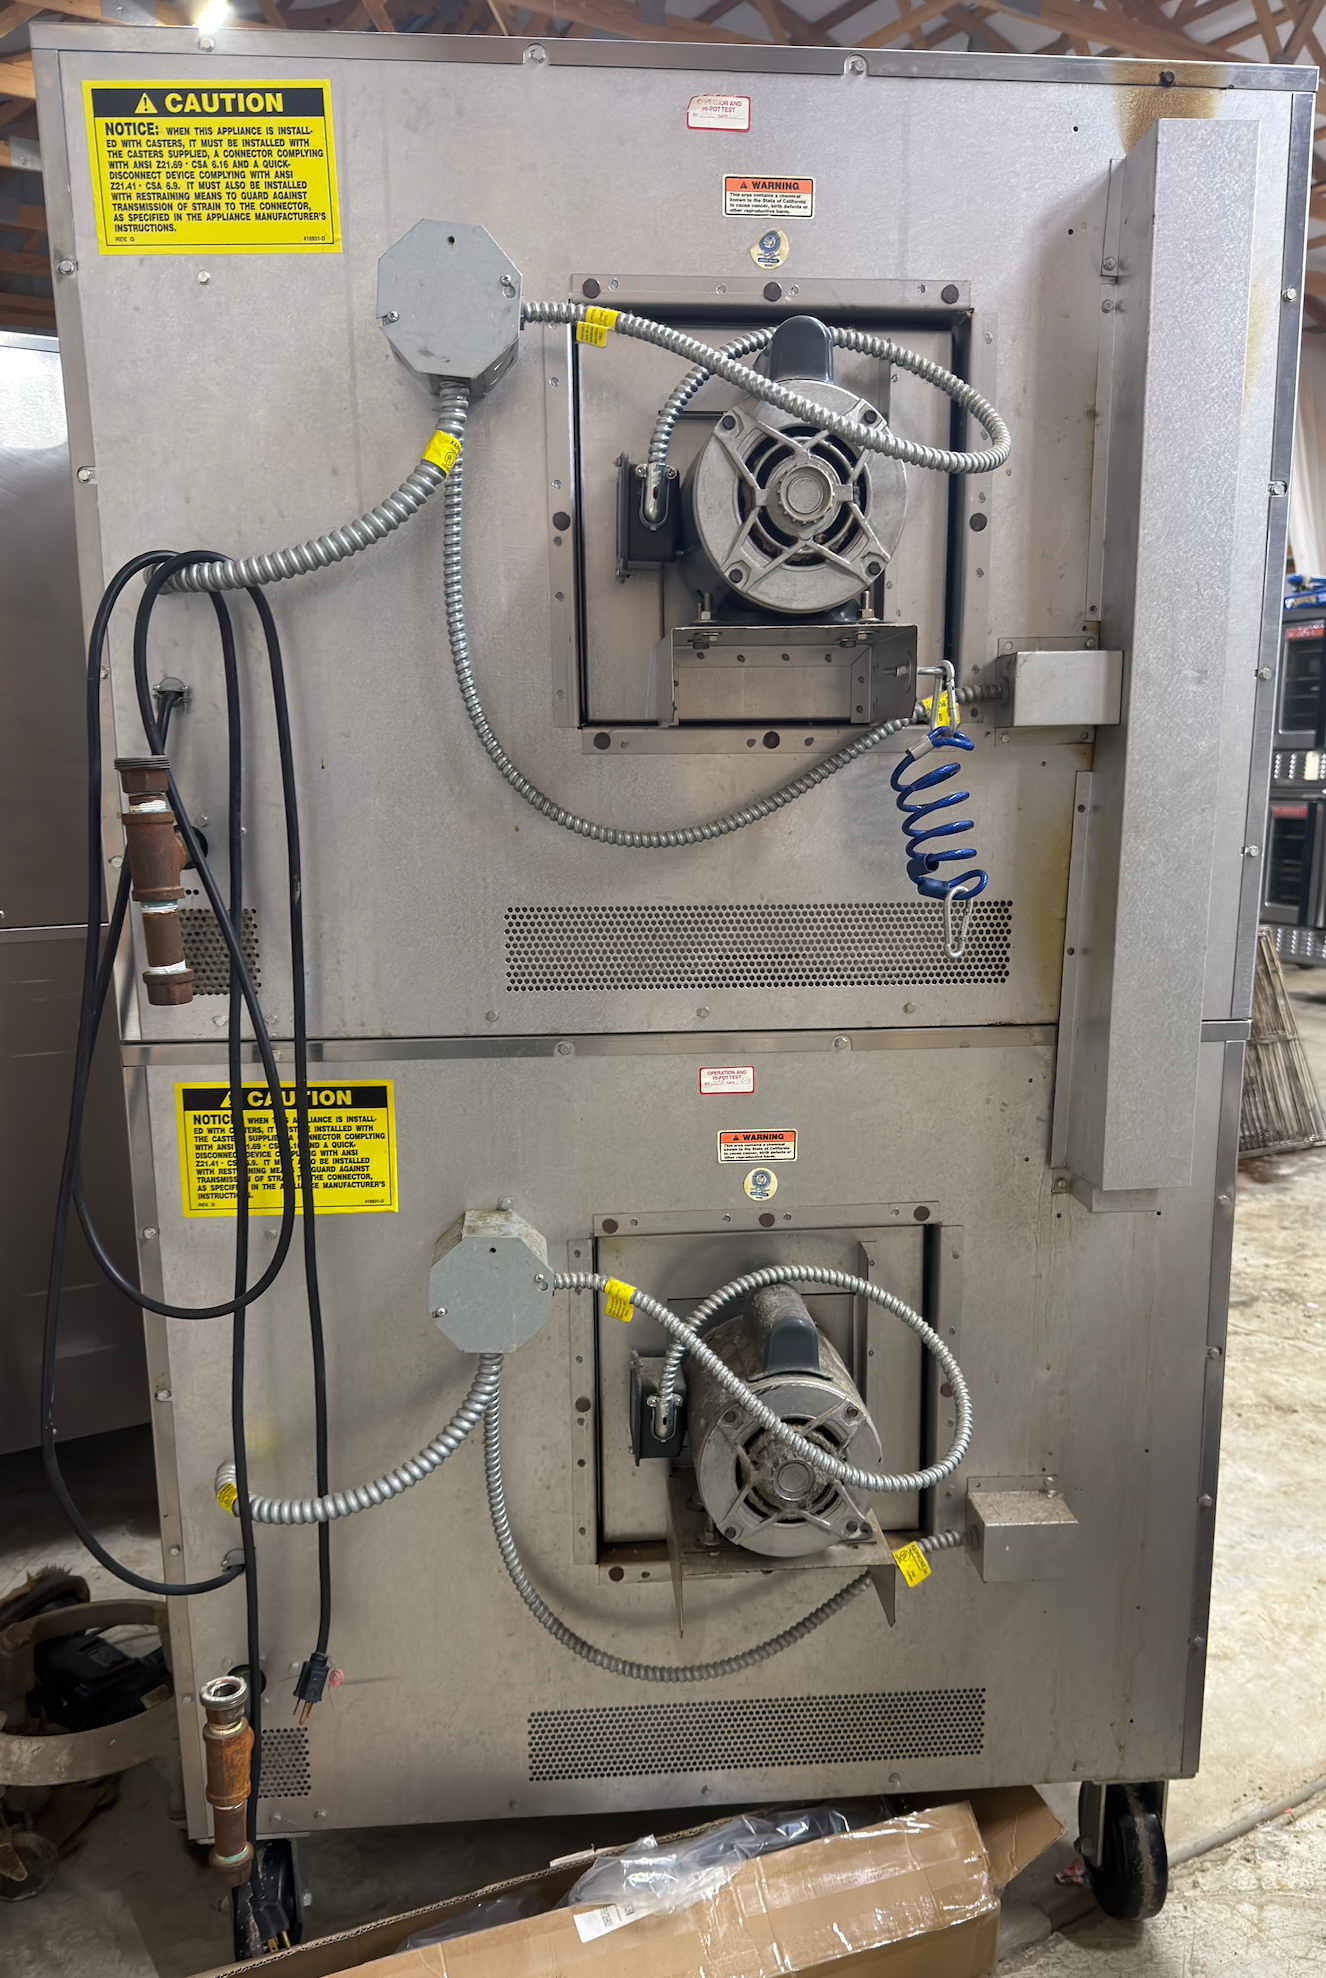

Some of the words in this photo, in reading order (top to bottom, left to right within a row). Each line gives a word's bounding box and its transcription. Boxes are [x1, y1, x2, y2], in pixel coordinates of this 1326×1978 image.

[164, 92, 284, 113] CAUTION
[105, 122, 159, 136] NOTICE:
[166, 127, 190, 136] WHEN
[194, 127, 213, 135] THIS
[216, 127, 262, 136] APPLIANCE
[265, 127, 274, 135] IS
[277, 126, 313, 135] INSTALL-
[106, 139, 117, 148] ED
[120, 139, 142, 148] WITH
[145, 139, 185, 149] CASTERS,
[189, 139, 197, 148] IT
[200, 139, 223, 148] MUST
[227, 139, 238, 148] BE
[241, 139, 285, 148] INSTALLED
[288, 139, 310, 148] WITH
[107, 150, 123, 158] THE
[126, 150, 164, 158] CASTERS
[167, 150, 210, 159] SUPPLIED,
[213, 150, 220, 158] A
[222, 150, 273, 158] CONNECTOR
[276, 150, 323, 158] COMPLYING
[108, 160, 129, 169] WITH
[133, 160, 153, 169] ANSI
[155, 160, 183, 169] Z21.69
[191, 160, 208, 169] CSA
[211, 160, 229, 169] 6.16
[232, 160, 249, 169] AND
[252, 160, 259, 169] A
[261, 160, 291, 169] QUICK-
[109, 171, 162, 179] DISCONNECT
[165, 171, 195, 179] DEVICE
[198, 171, 246, 179] COMPLYING
[249, 171, 270, 179] WITH
[274, 171, 293, 179] ANSI
[110, 181, 137, 190] Z21.41
[145, 181, 162, 190] CSA
[165, 181, 181, 190] 6.9.
[186, 181, 194, 190] IT
[198, 181, 222, 190] MUST
[225, 181, 246, 190] ALSO
[249, 181, 260, 190] BE
[264, 181, 307, 190] INSTALLED
[751, 181, 799, 190] WARNING
[110, 192, 132, 200] WITH
[136, 192, 190, 200] RESTRAINING
[193, 192, 222, 200] MEANS
[225, 192, 237, 200] TO
[240, 192, 269, 200] GUARD
[271, 192, 308, 200] AGAINST
[112, 202, 174, 211] TRANSMISSION
[177, 202, 188, 211] OF
[191, 202, 221, 211] STRAIN
[224, 202, 236, 211] TO
[239, 202, 255, 211] THE
[258, 202, 312, 211] CONNECTOR,
[113, 213, 124, 222] AS
[127, 213, 170, 222] SPECIFIED
[173, 213, 182, 222] IN
[186, 213, 202, 222] THE
[206, 212, 251, 221] APPLIANCE
[254, 212, 327, 221] MANUFACTURER'S
[114, 223, 177, 232] INSTRUCTIONS.
[247, 1090, 352, 1107] CAUION
[314, 1124, 352, 1132] INSTALLED
[742, 1133, 784, 1141] WARNING
[331, 1141, 356, 1149] QUICK-
[327, 1173, 372, 1181] CONNECTOR,
[322, 1181, 386, 1189] MANUFACTURER'S
